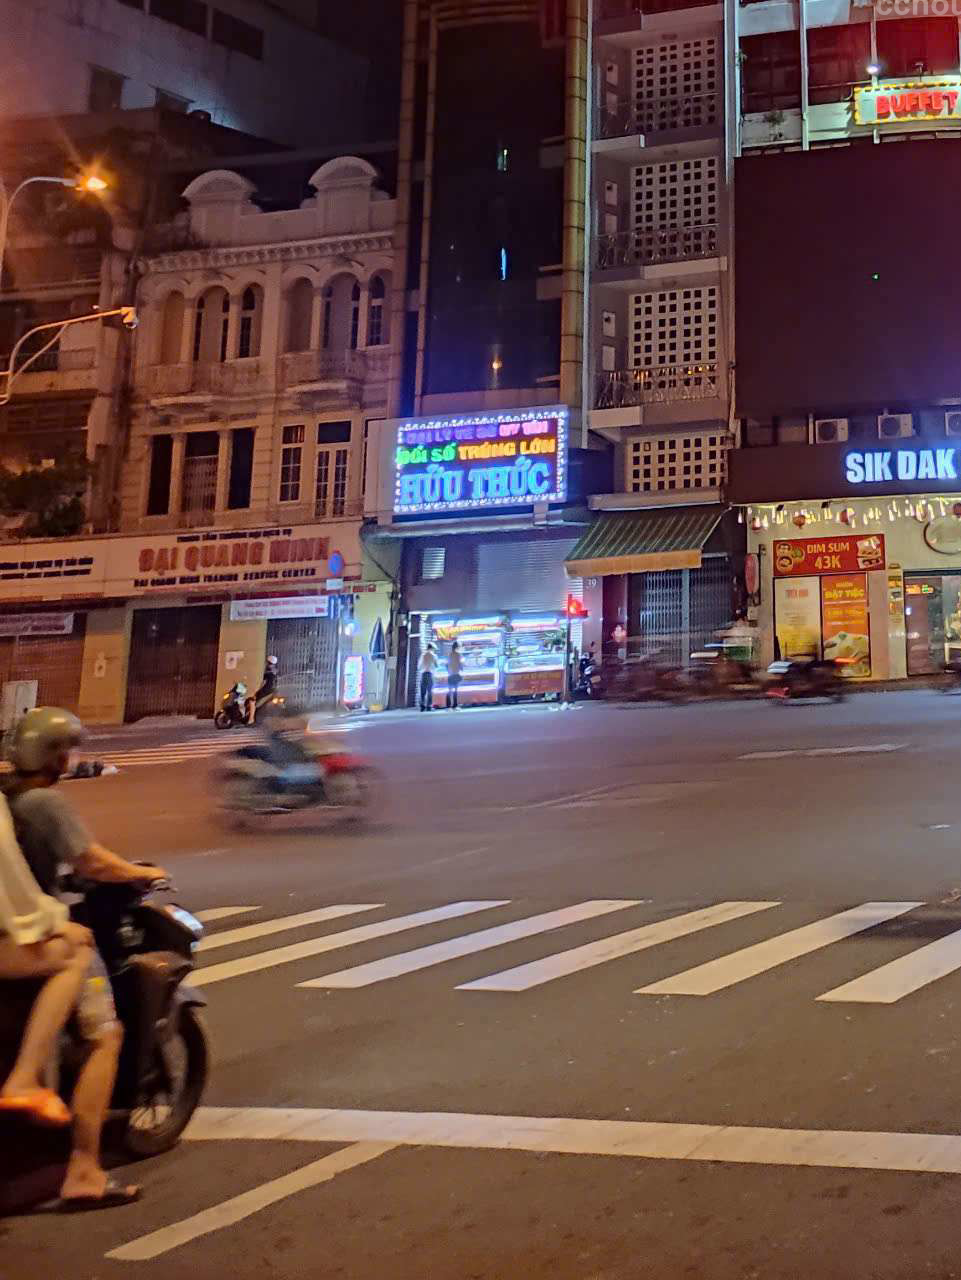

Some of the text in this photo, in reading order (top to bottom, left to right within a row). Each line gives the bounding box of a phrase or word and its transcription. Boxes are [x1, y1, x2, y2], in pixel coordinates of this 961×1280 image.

[876, 90, 958, 117] BUFFET
[431, 442, 458, 462] SỐ
[459, 441, 516, 460] TRÚNG
[520, 438, 555, 455] LỚN
[846, 452, 893, 483] SIK
[897, 448, 958, 480] DAK
[400, 456, 549, 504] HỮU THỨC
[139, 536, 330, 575] ĐẠI QUANG MINH
[807, 542, 850, 554] DIM SUM
[814, 555, 841, 569] 43K
